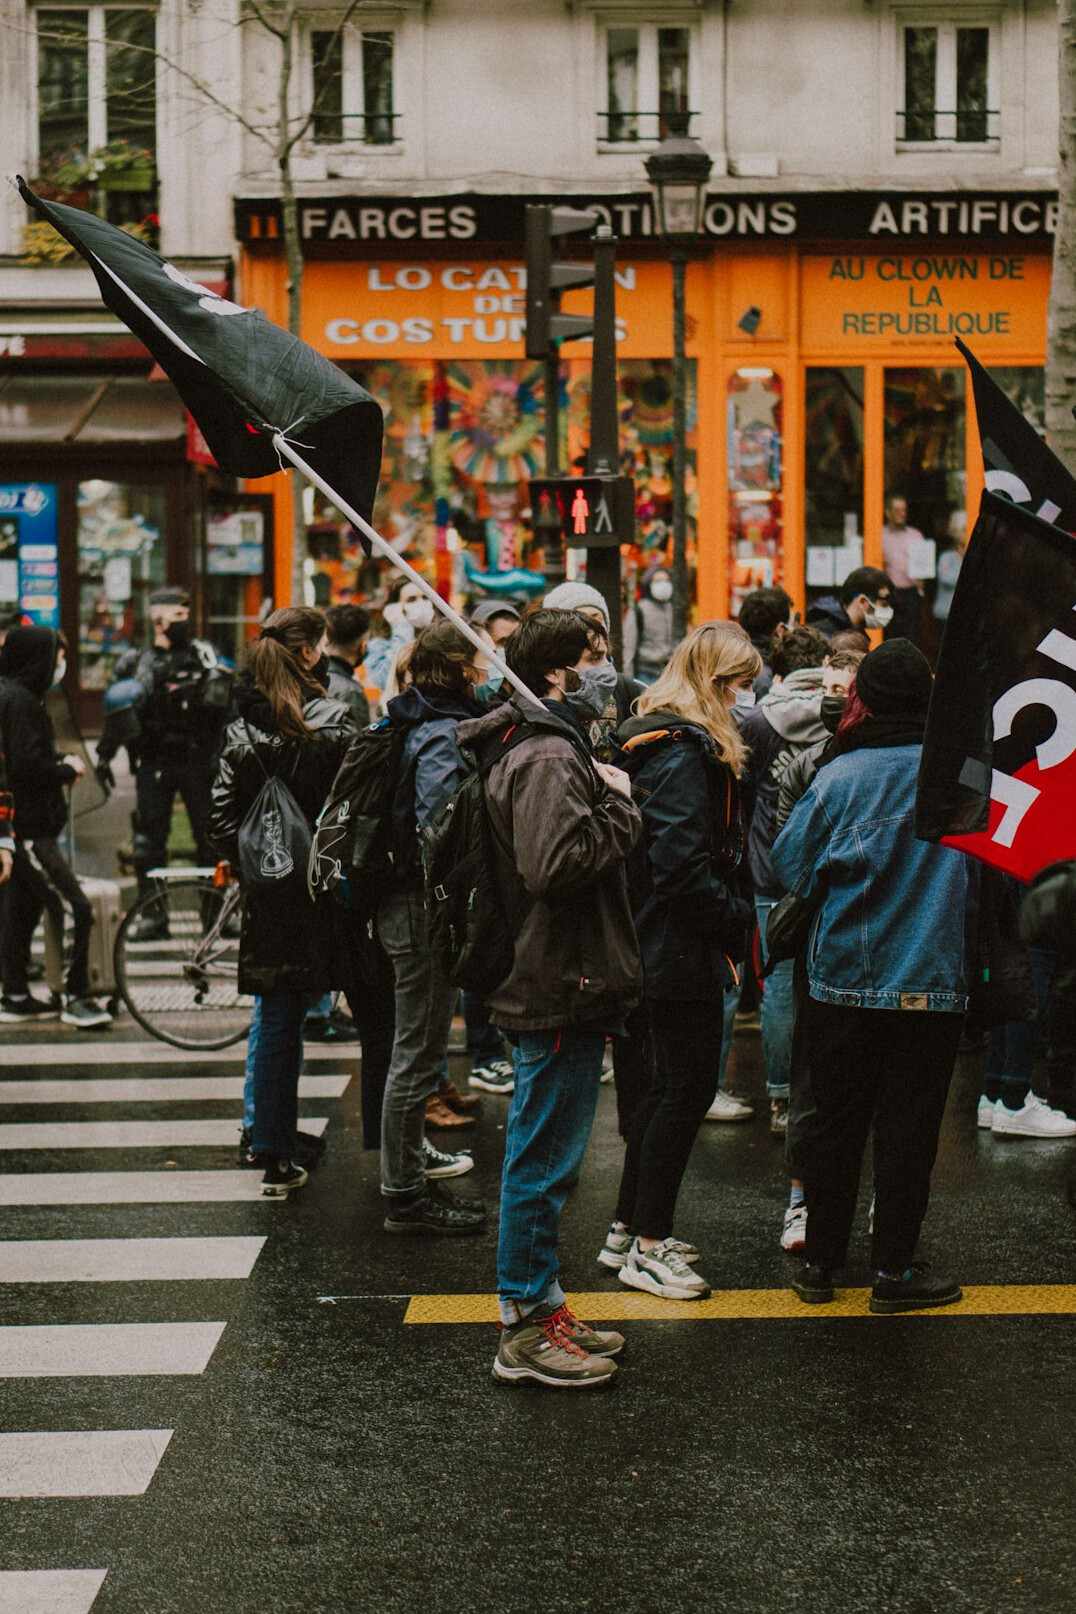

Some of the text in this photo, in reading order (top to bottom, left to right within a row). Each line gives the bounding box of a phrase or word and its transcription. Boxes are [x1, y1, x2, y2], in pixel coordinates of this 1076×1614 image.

[302, 205, 477, 240] FARCES
[829, 256, 1025, 281] AU CLOWN DE
[473, 294, 526, 314] DE
[908, 285, 943, 307] LA
[842, 311, 1011, 335] REPUBLIQUE
